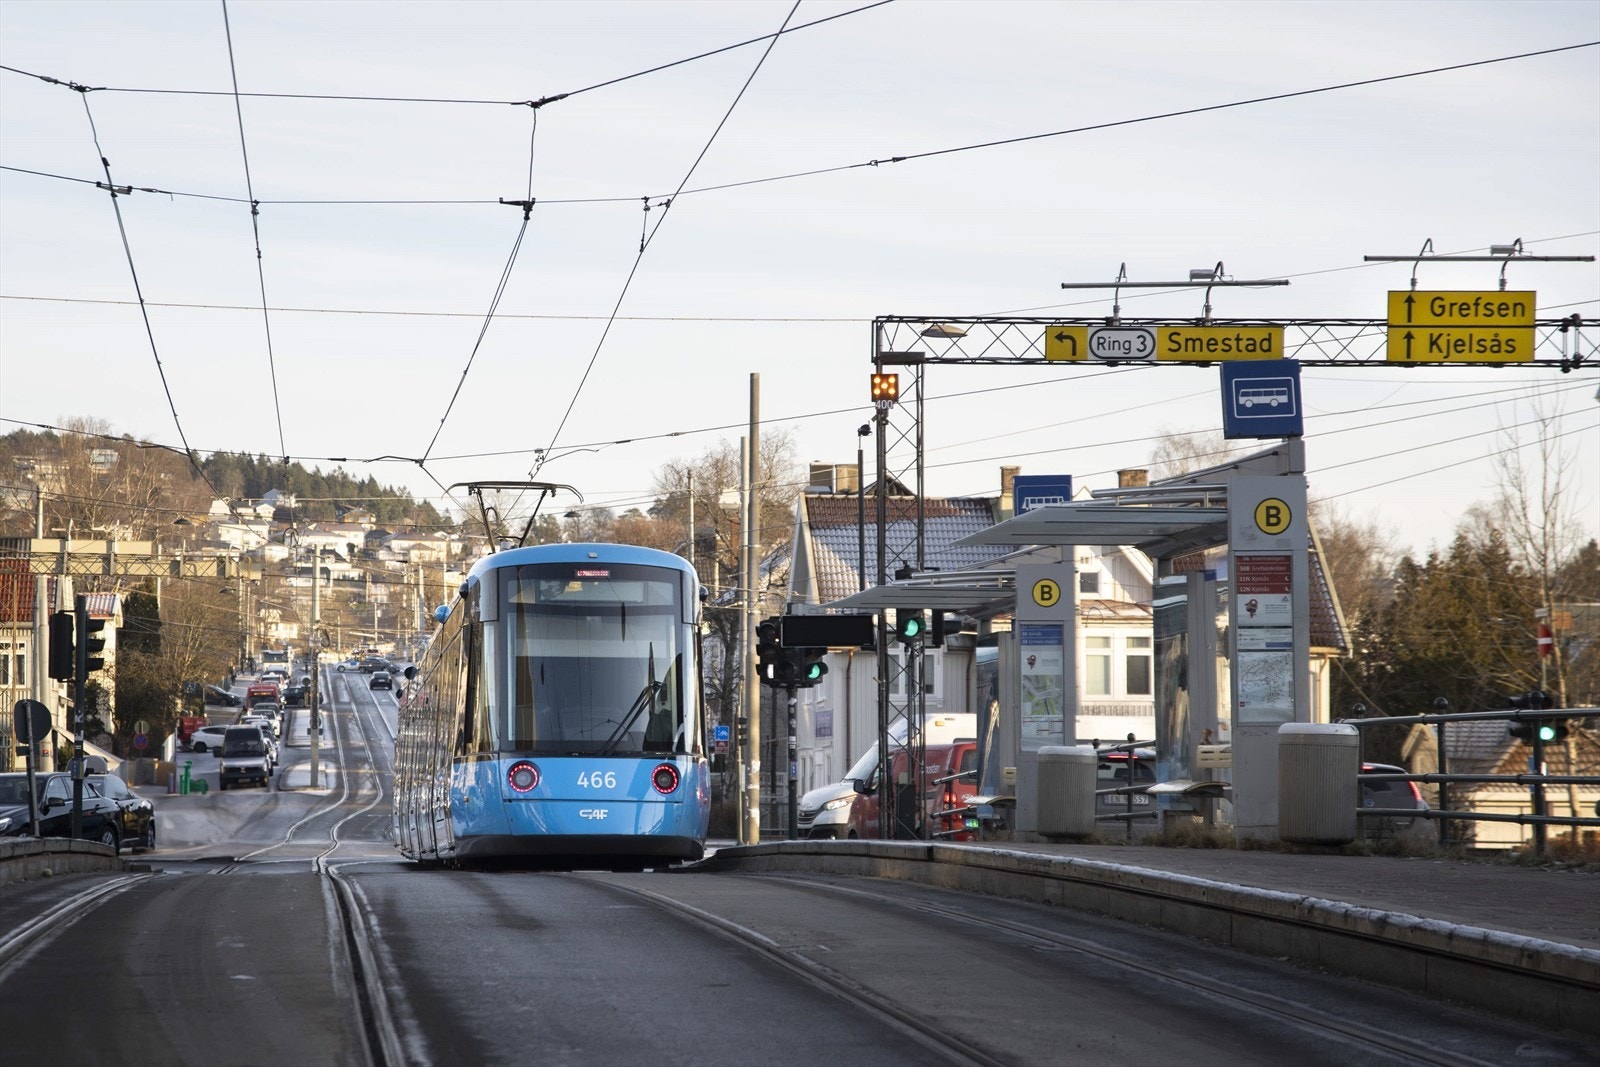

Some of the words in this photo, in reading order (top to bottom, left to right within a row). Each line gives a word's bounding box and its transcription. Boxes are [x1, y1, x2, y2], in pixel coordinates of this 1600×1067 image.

[1429, 296, 1526, 318] Grefsen
[1096, 336, 1132, 355] Ring
[1136, 334, 1148, 353] 3
[1167, 331, 1273, 353] Smestad
[1428, 332, 1517, 359] Kjelsås
[876, 399, 893, 409] 400
[1265, 505, 1282, 527] B
[1040, 584, 1053, 601] B
[577, 771, 617, 788] 466
